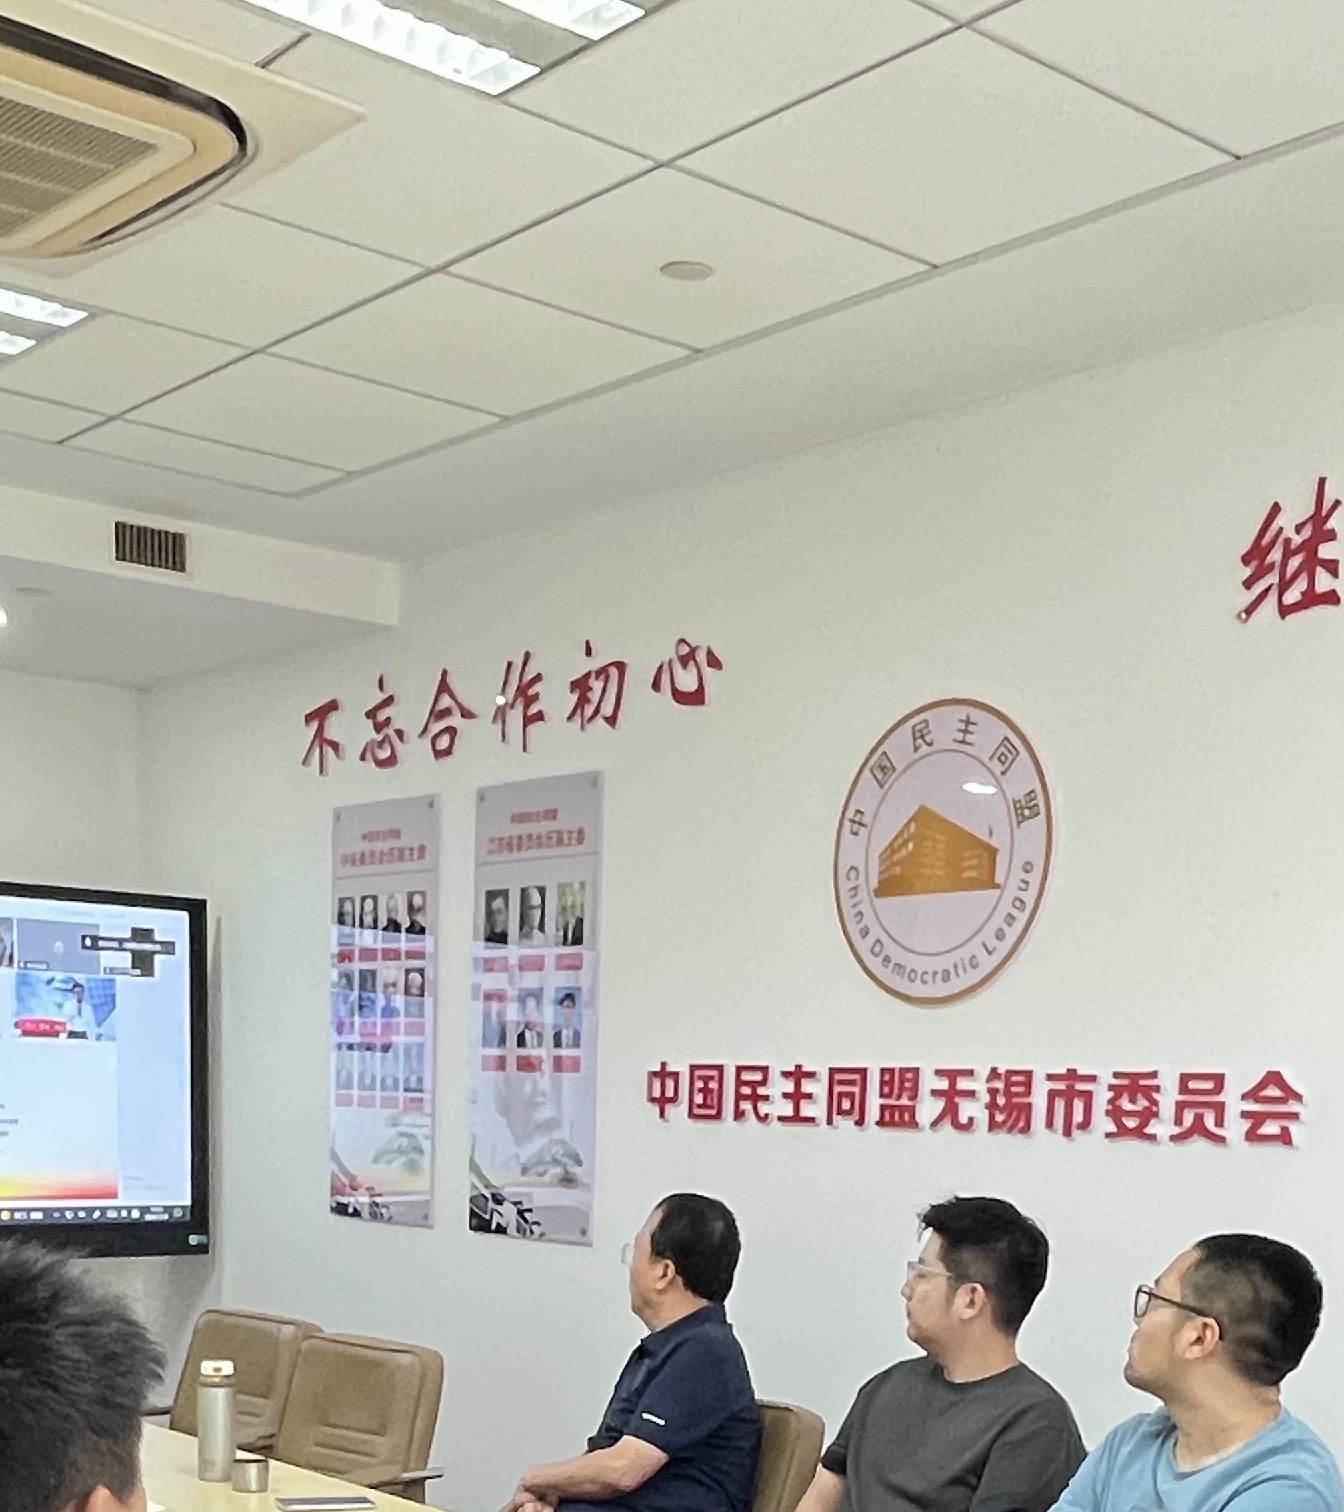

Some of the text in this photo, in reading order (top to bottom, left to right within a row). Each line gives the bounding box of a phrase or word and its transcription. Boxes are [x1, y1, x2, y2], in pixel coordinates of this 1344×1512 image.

[301, 638, 723, 776] 不忘合作初心
[848, 713, 1042, 836] 中国民主同盟
[845, 865, 871, 941] China
[871, 938, 980, 985] Democratic
[647, 1062, 1304, 1147] 中国民主同盟无锡市委员会
